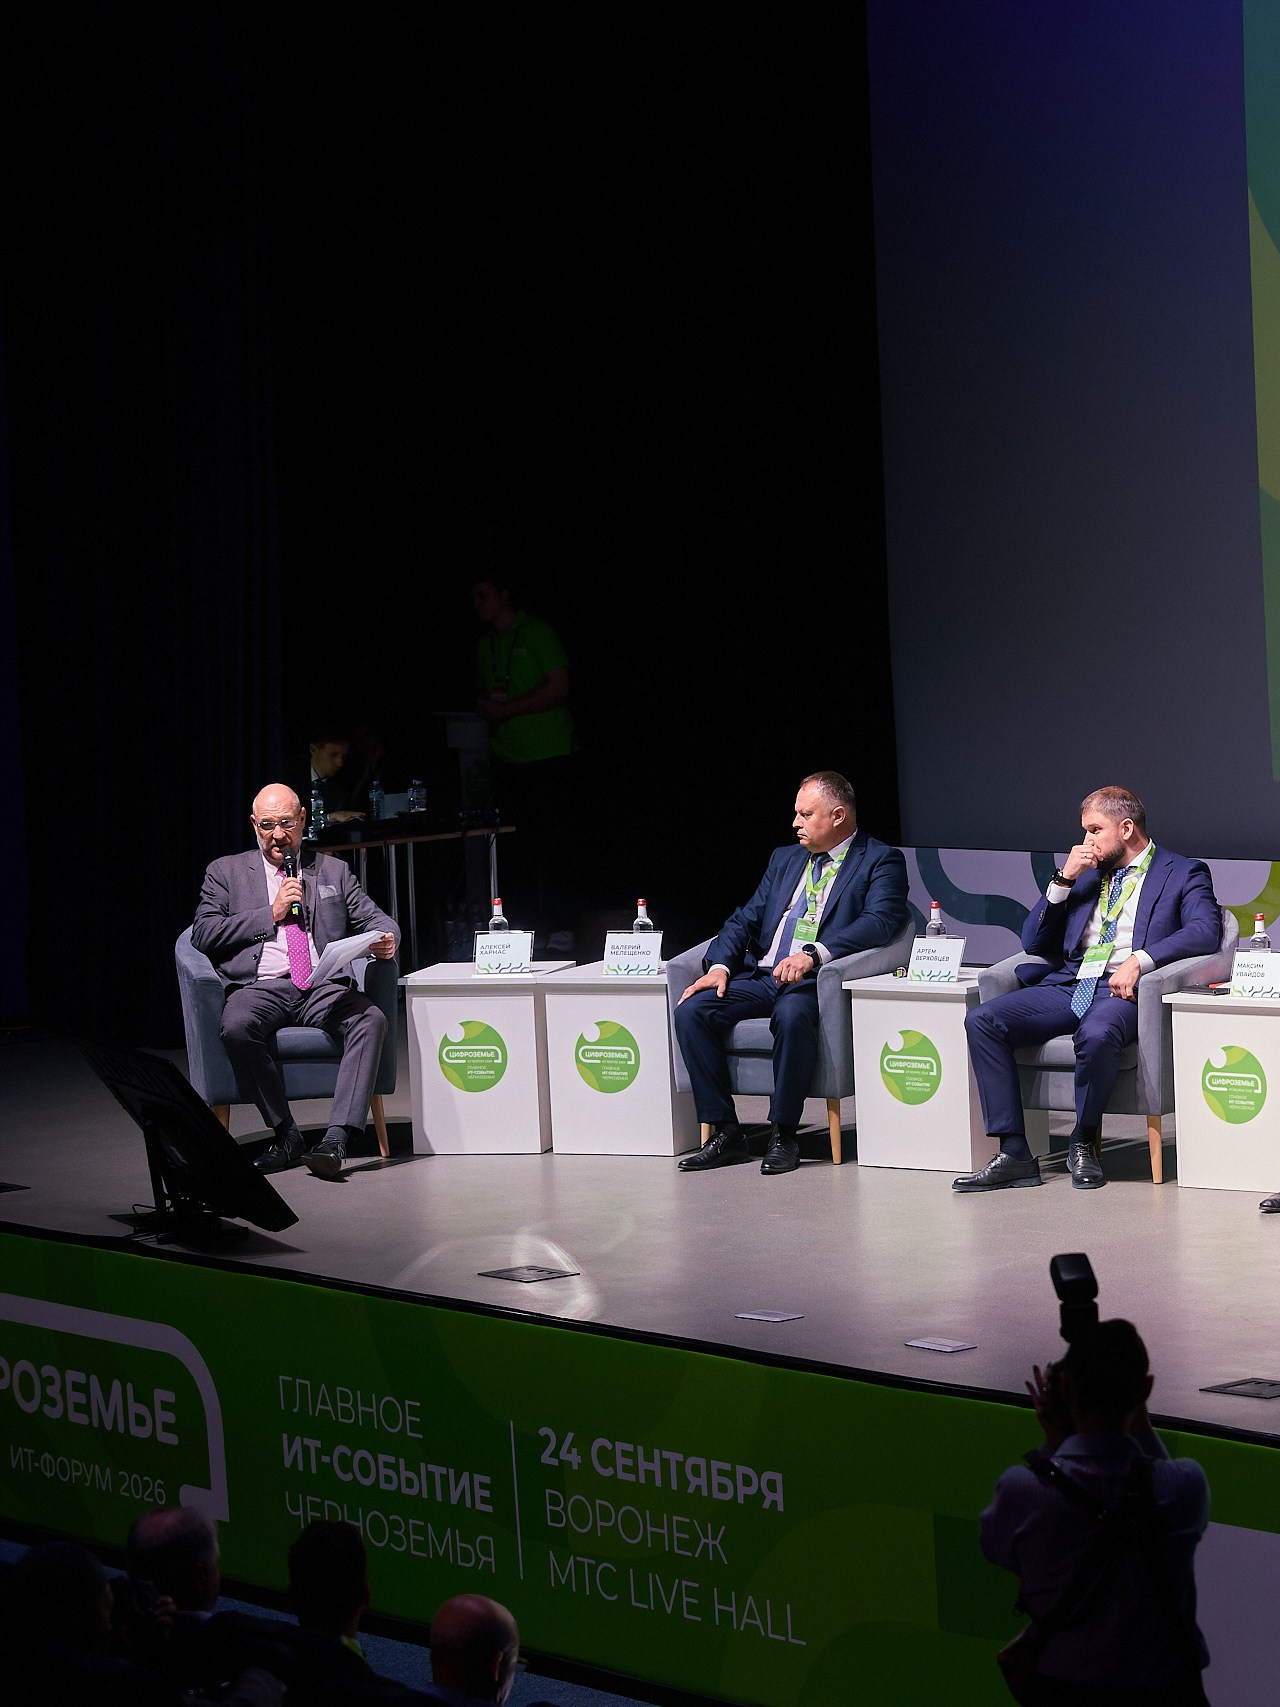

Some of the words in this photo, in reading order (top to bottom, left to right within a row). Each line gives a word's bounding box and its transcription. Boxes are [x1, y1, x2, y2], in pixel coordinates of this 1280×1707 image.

[1235, 970, 1265, 978] УВАЙДОВ
[585, 1051, 628, 1059] ЦИФРОЗЕМЬЕ
[889, 1061, 930, 1070] ЦИФРОЗЕМЬЕ
[1211, 1078, 1255, 1087] ЦИФРОЗЕМЬЕ
[279, 1376, 423, 1439] ГЛАВНОЕ
[10, 1445, 112, 1492] ИТ-ФОРУМ
[119, 1471, 166, 1505] 2026
[282, 1433, 493, 1513] ИТ-СОБЫТИЕ
[538, 1426, 582, 1470] 24
[591, 1437, 785, 1512] СЕНТЯБРЯ
[545, 1488, 728, 1565] ВОРОНЕЖ
[550, 1550, 618, 1600] МТС
[630, 1568, 702, 1622] LIVE
[713, 1587, 807, 1646] HALL
